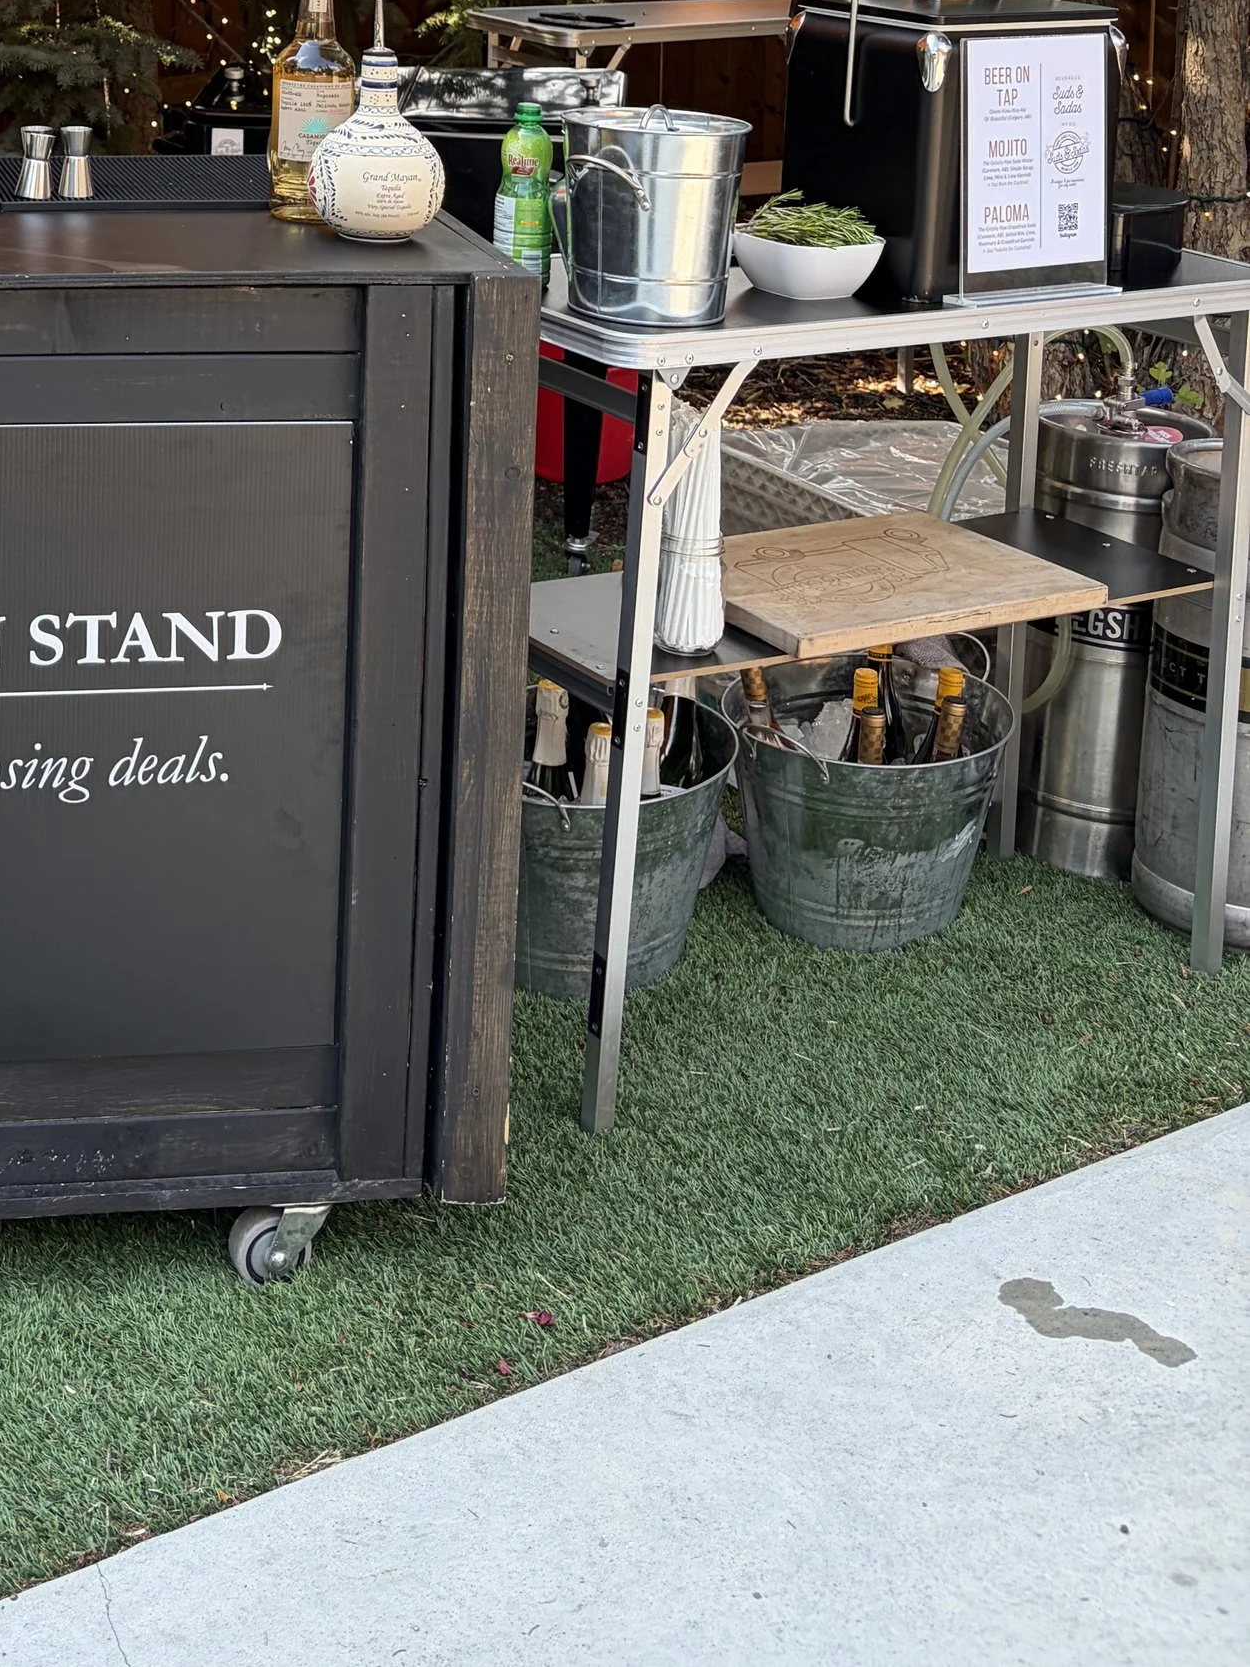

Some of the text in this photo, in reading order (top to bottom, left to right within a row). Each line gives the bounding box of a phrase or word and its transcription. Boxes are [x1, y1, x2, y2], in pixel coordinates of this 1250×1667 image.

[984, 65, 1030, 85] BEER ON
[996, 88, 1018, 106] TAP
[1052, 84, 1084, 100] Suds &
[1053, 100, 1082, 115] Sodas
[988, 138, 1027, 158] MOJITO
[362, 172, 418, 184] Grand Mayan
[381, 185, 401, 193] Tequila
[984, 203, 1029, 224] PALOMA
[29, 609, 283, 665] STAND
[108, 736, 229, 787] deals.
